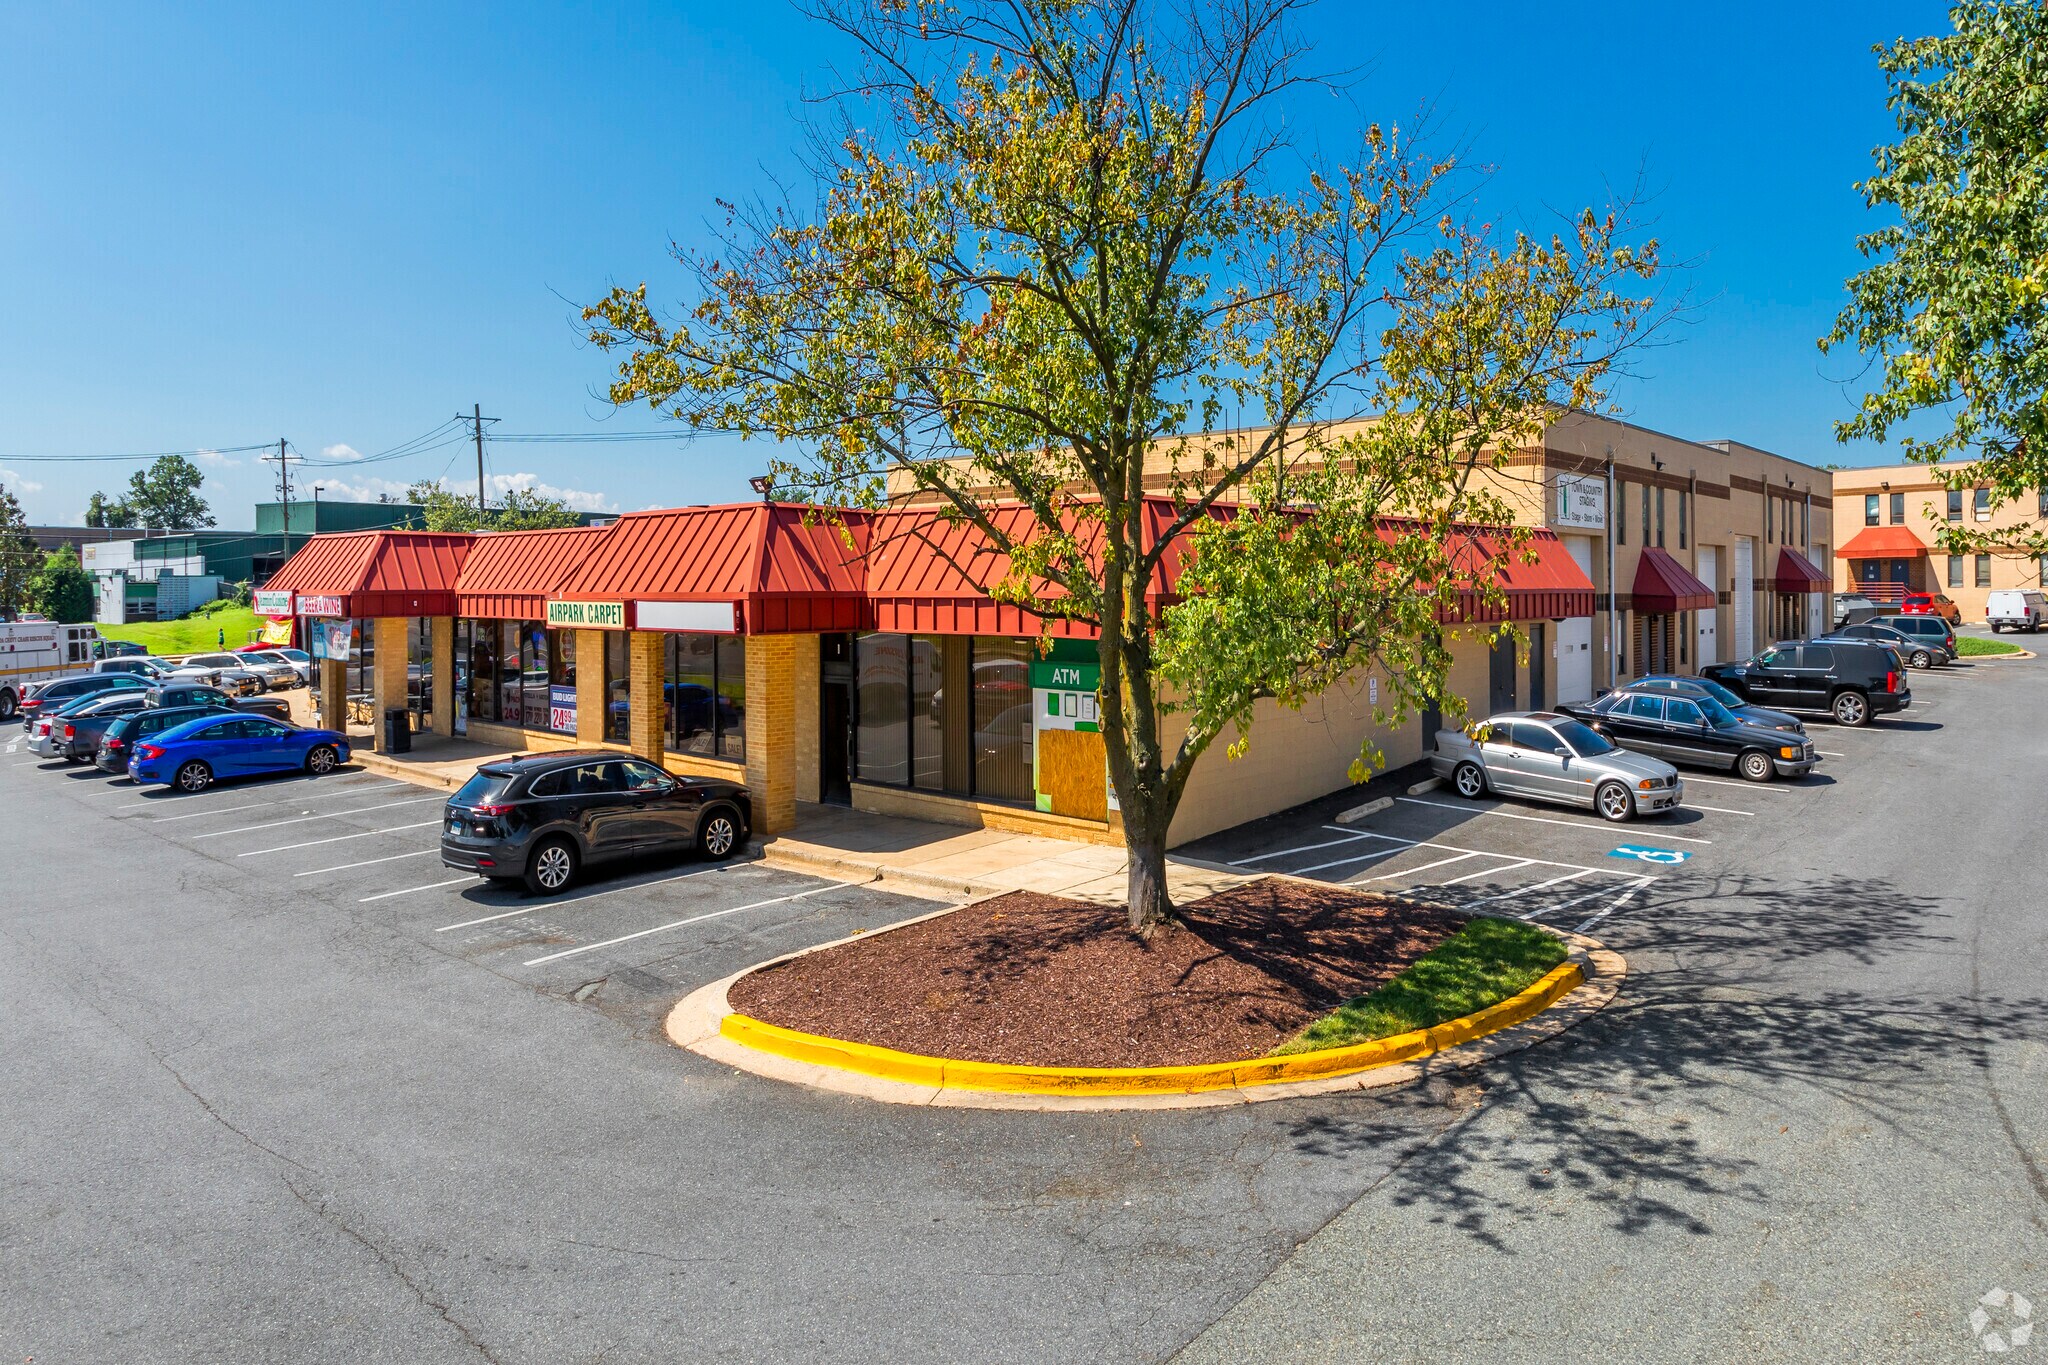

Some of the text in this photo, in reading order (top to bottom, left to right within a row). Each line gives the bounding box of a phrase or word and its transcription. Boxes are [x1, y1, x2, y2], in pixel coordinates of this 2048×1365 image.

[1572, 482, 1582, 493] TOWN
[1586, 484, 1602, 496] COUNTRY
[1579, 495, 1595, 507] STAGING
[305, 597, 318, 612] BEER
[323, 597, 340, 614] WINE
[549, 603, 622, 625] AIRPARK CARPET
[1052, 668, 1080, 685] ATM
[552, 692, 562, 701] BUD
[505, 707, 520, 721] 24.9
[727, 742, 742, 753] SALE!
